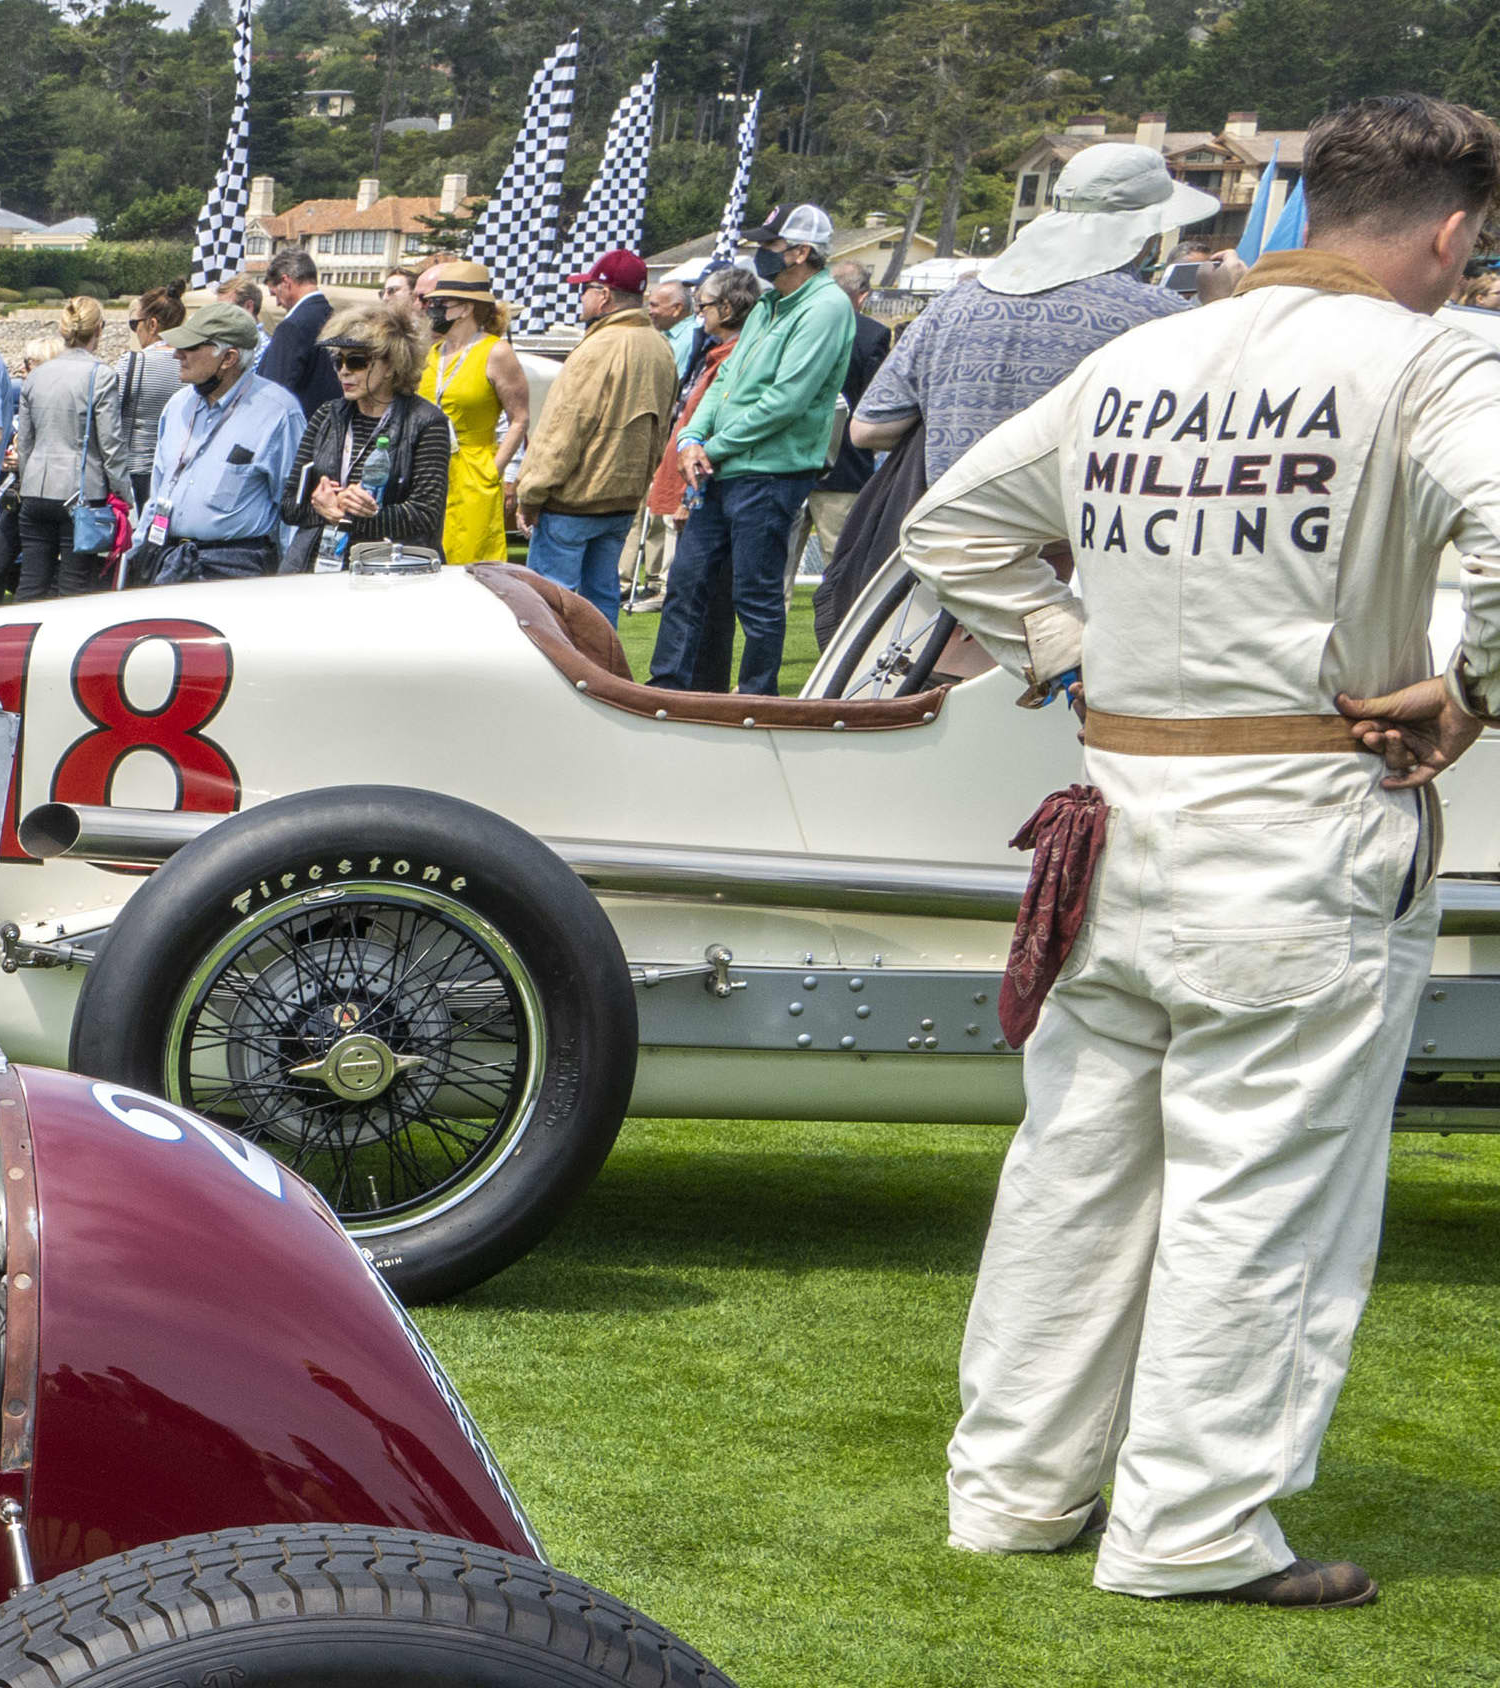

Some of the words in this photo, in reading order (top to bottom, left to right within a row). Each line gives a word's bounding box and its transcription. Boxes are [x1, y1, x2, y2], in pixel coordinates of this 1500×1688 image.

[1084, 451, 1338, 497] MILLER
[1080, 503, 1331, 557] RACING
[231, 856, 468, 915] Firestone
[375, 1256, 403, 1269] HIGH
